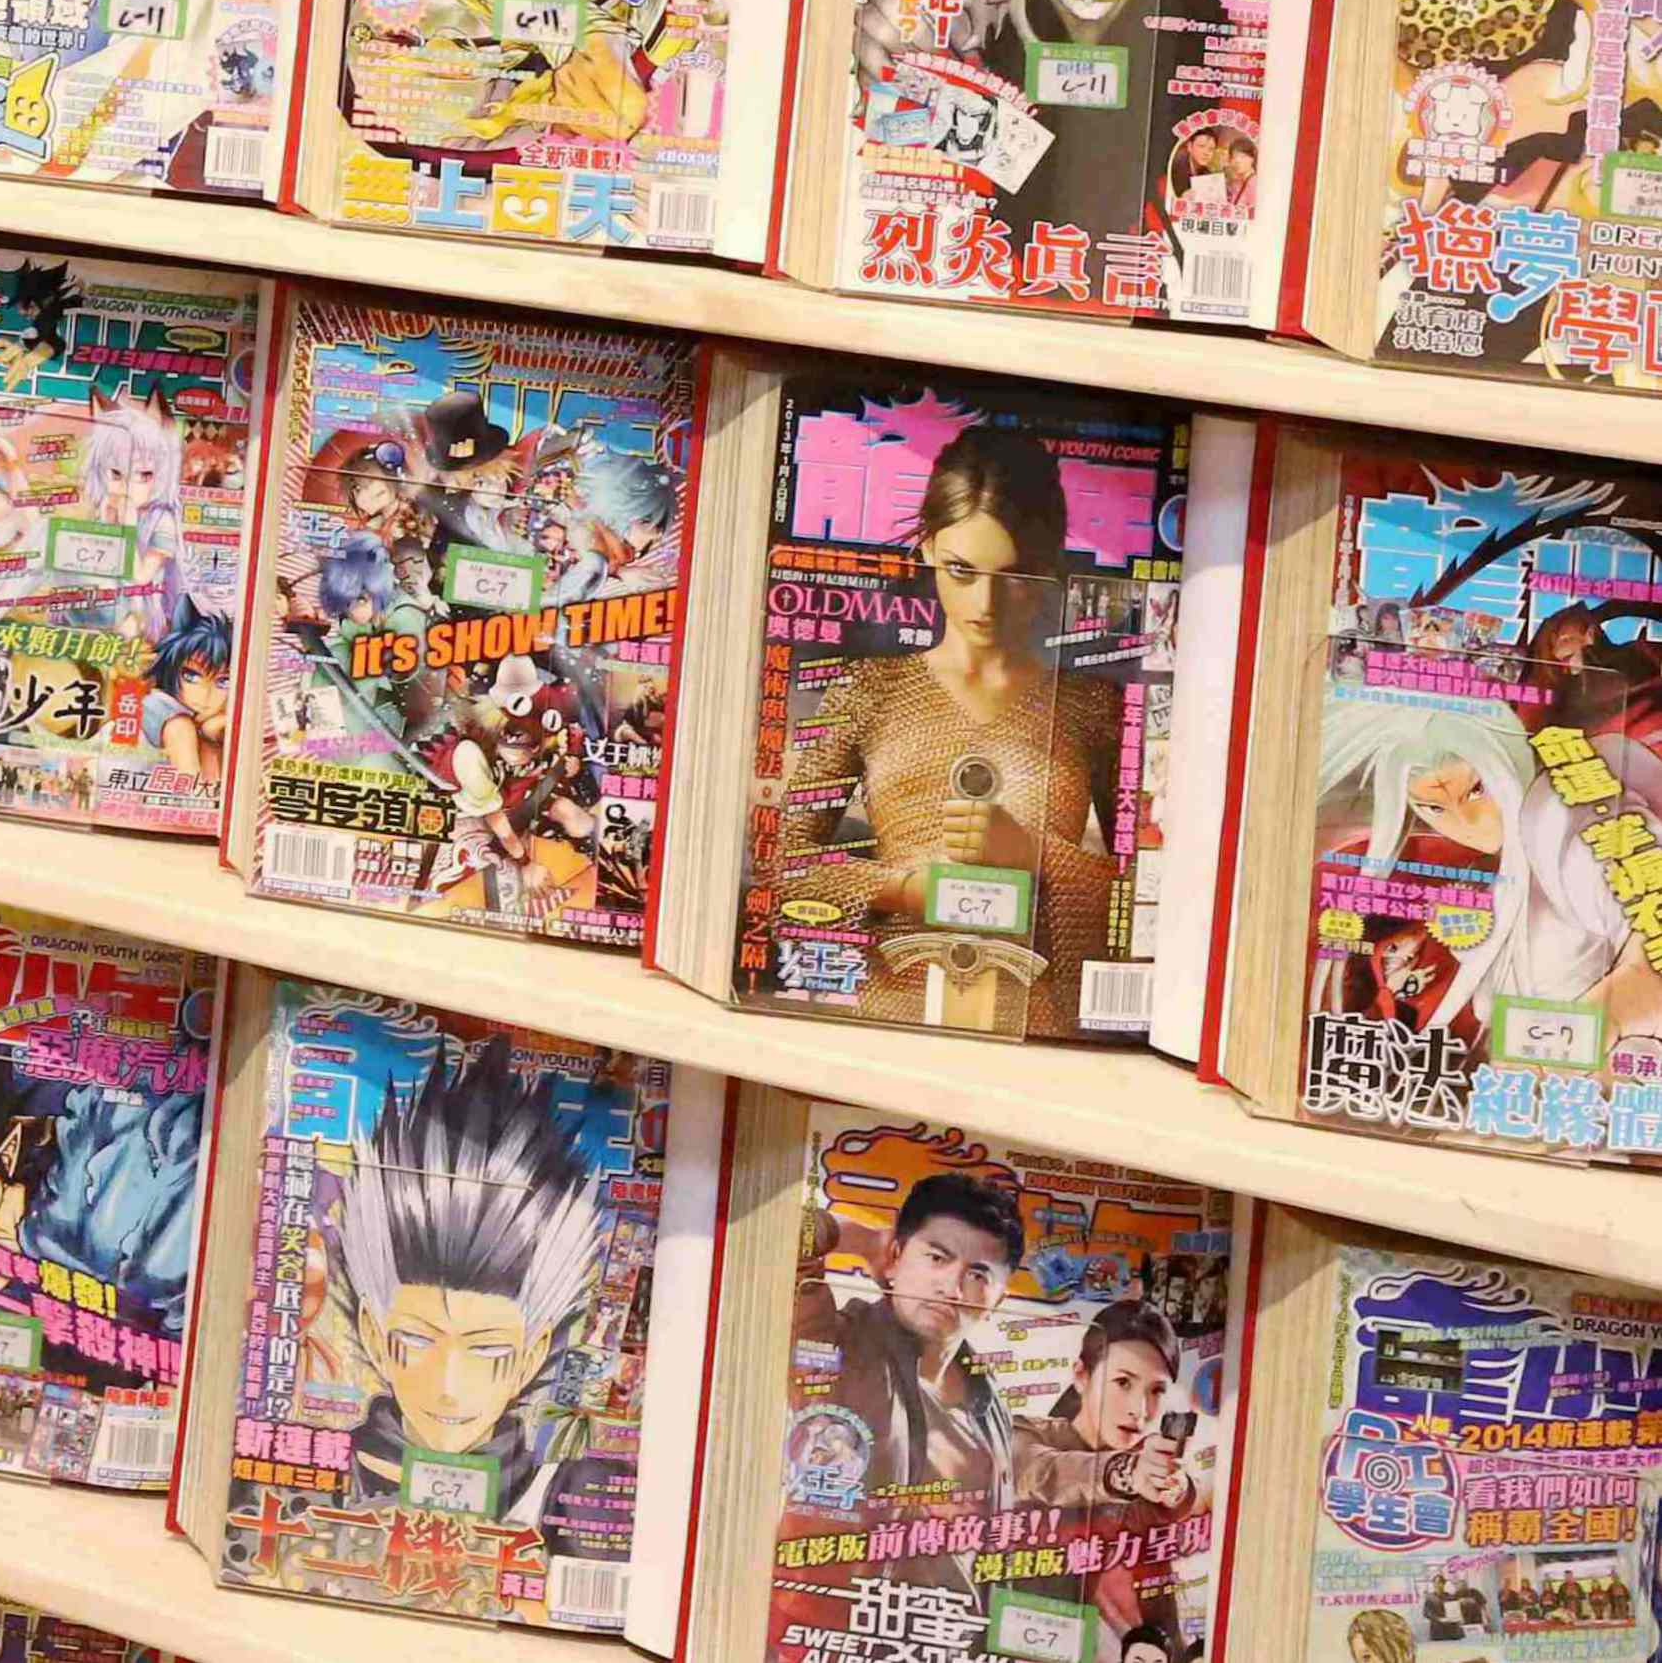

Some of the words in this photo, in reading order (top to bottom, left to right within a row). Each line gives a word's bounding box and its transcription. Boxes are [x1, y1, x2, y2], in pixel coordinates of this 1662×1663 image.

[140, 301, 186, 320] YOUTH
[189, 304, 236, 324] COMIC
[76, 546, 107, 564] C-7
[474, 576, 510, 597] C-7
[767, 583, 939, 628] OLDMAN
[425, 607, 560, 672] SHOW
[560, 588, 678, 650] TIME!
[958, 895, 994, 917] C-7
[91, 940, 138, 960] YOUTH
[1572, 1316, 1646, 1339] DRAGON
[430, 1480, 462, 1500] C-7
[1465, 1474, 1636, 1509] 看我們如何
[1023, 1625, 1059, 1647] C-7
